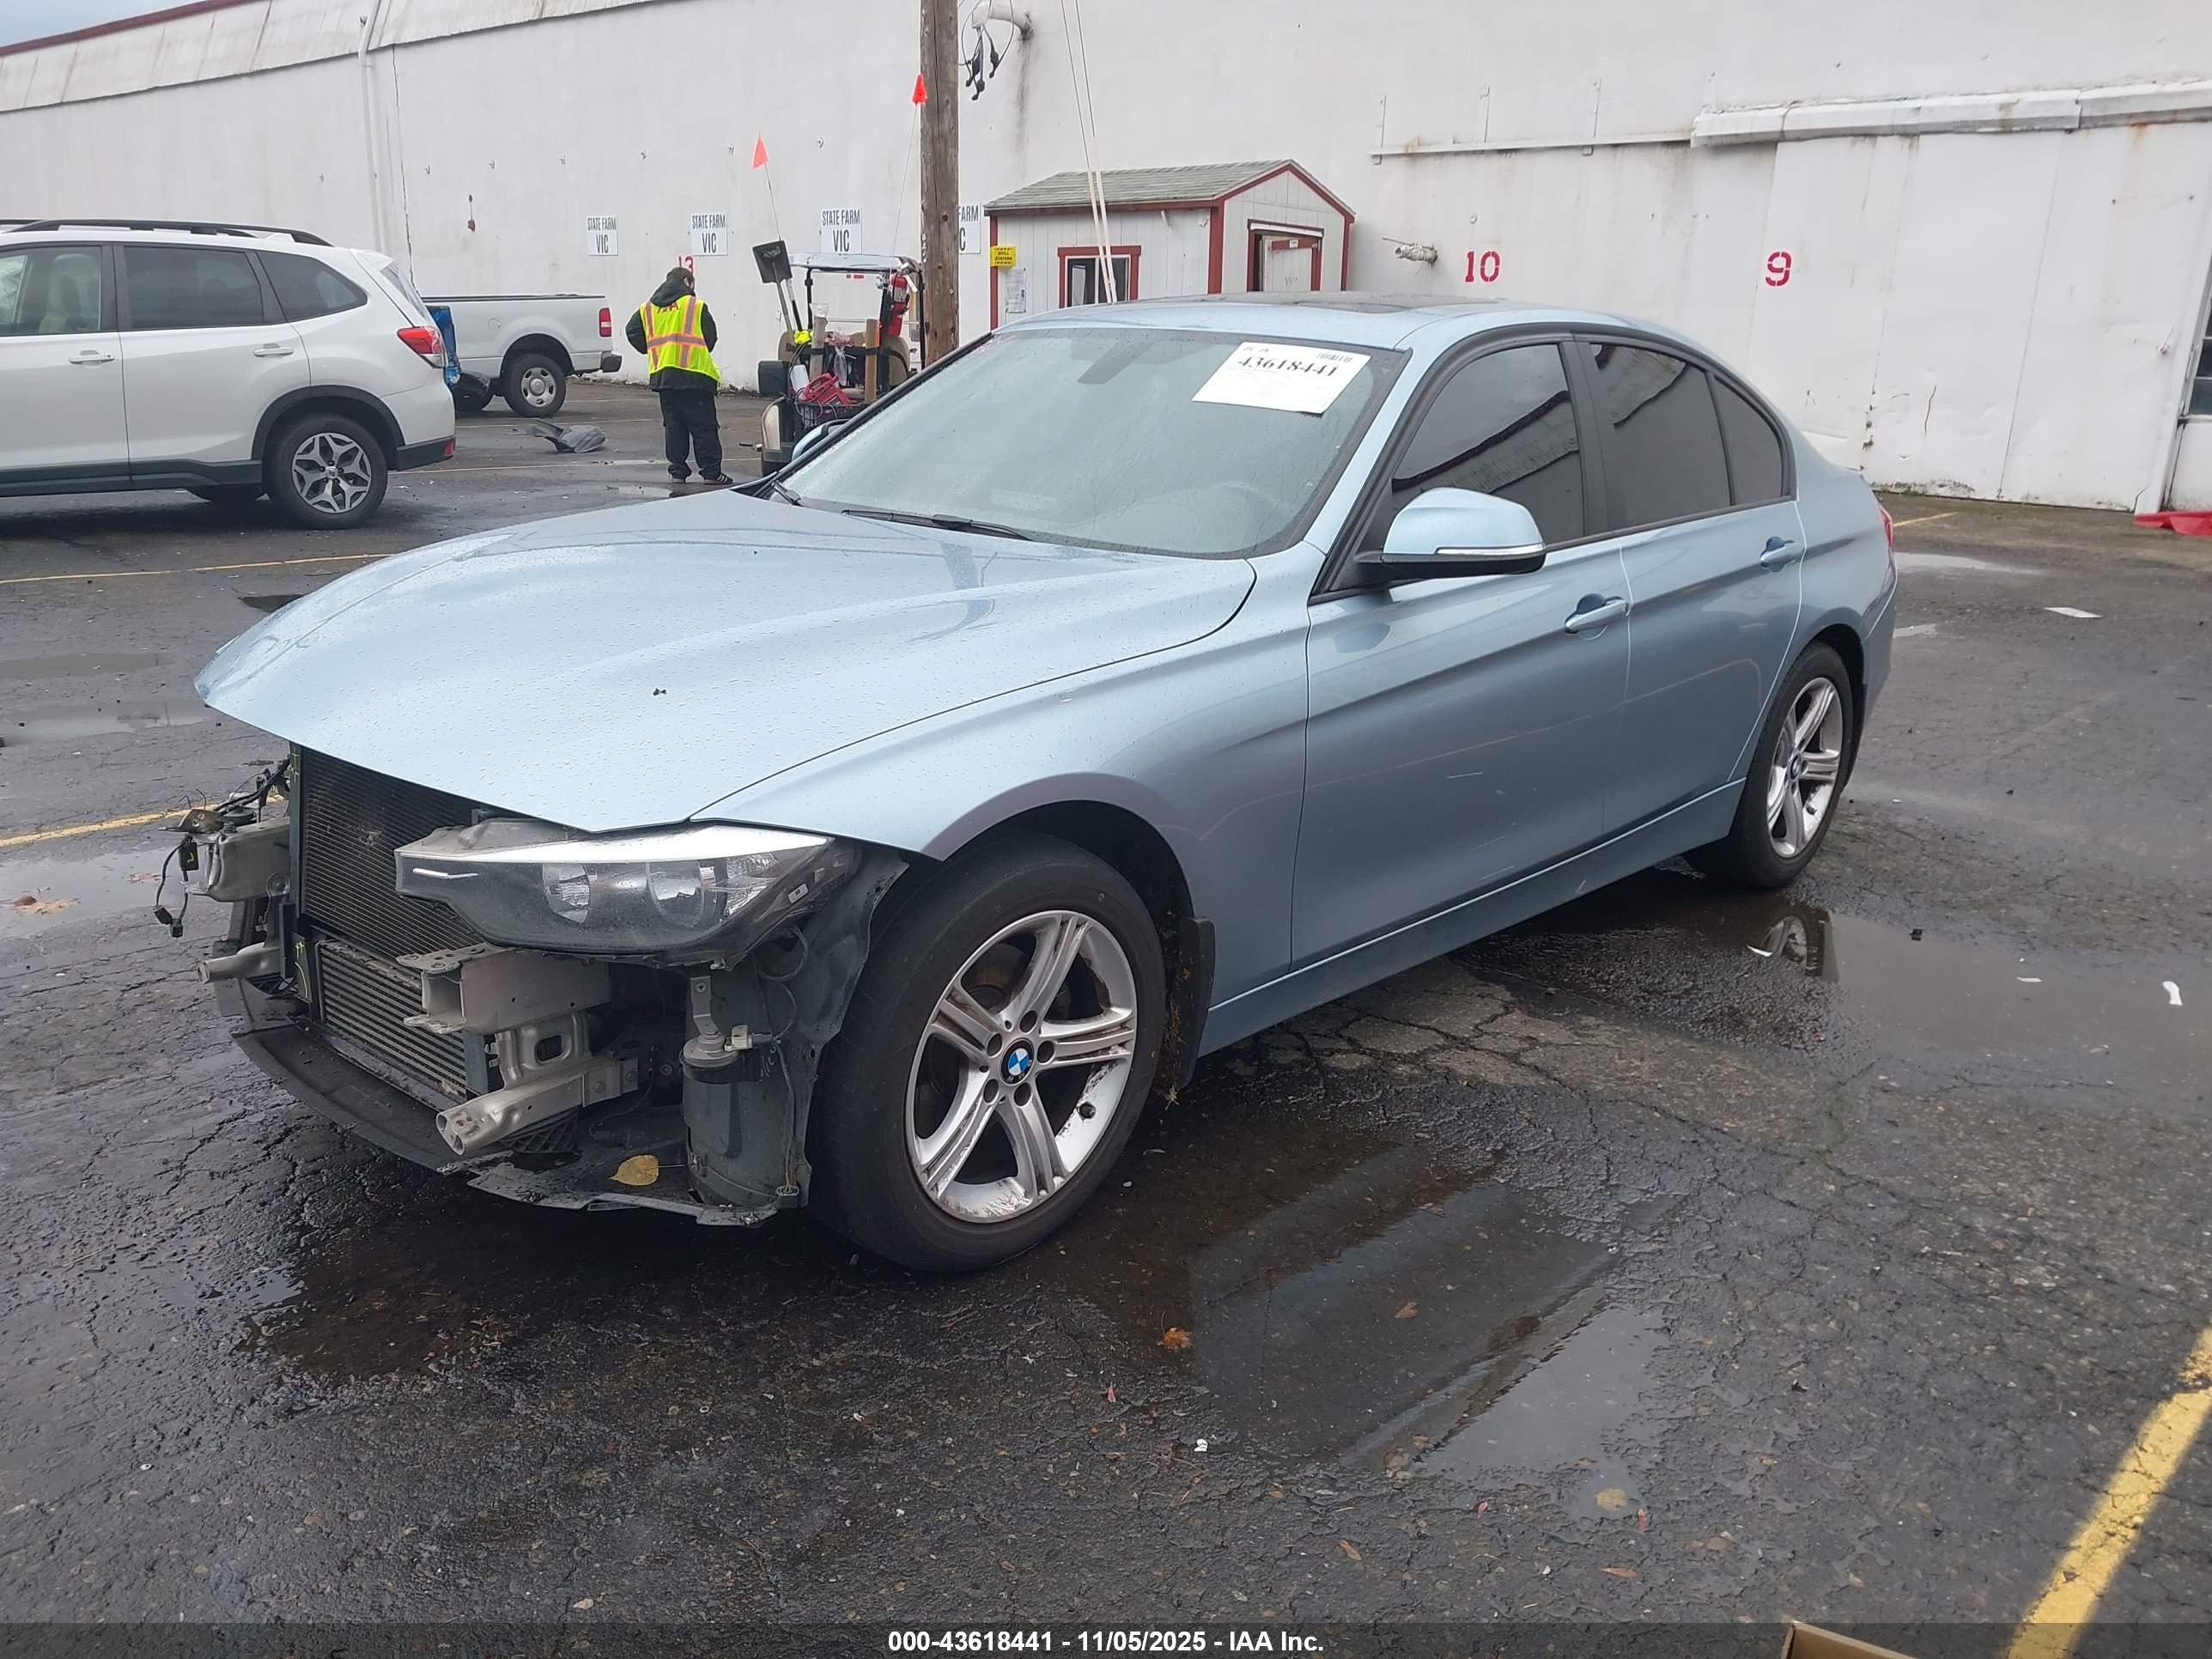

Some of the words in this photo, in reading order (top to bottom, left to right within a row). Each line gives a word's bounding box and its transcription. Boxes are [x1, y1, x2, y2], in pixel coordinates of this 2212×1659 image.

[586, 217, 601, 231] STATE
[602, 216, 617, 230] FARM
[692, 215, 708, 229] STATE
[709, 214, 726, 228] FARM
[822, 210, 839, 226] STATE
[841, 209, 860, 224] FARM
[596, 234, 609, 253] VIC
[702, 233, 717, 253] VIC
[833, 228, 850, 252] VIC
[1465, 250, 1501, 283] 10
[1765, 252, 1792, 287] 9
[1238, 356, 1338, 376] 43618441
